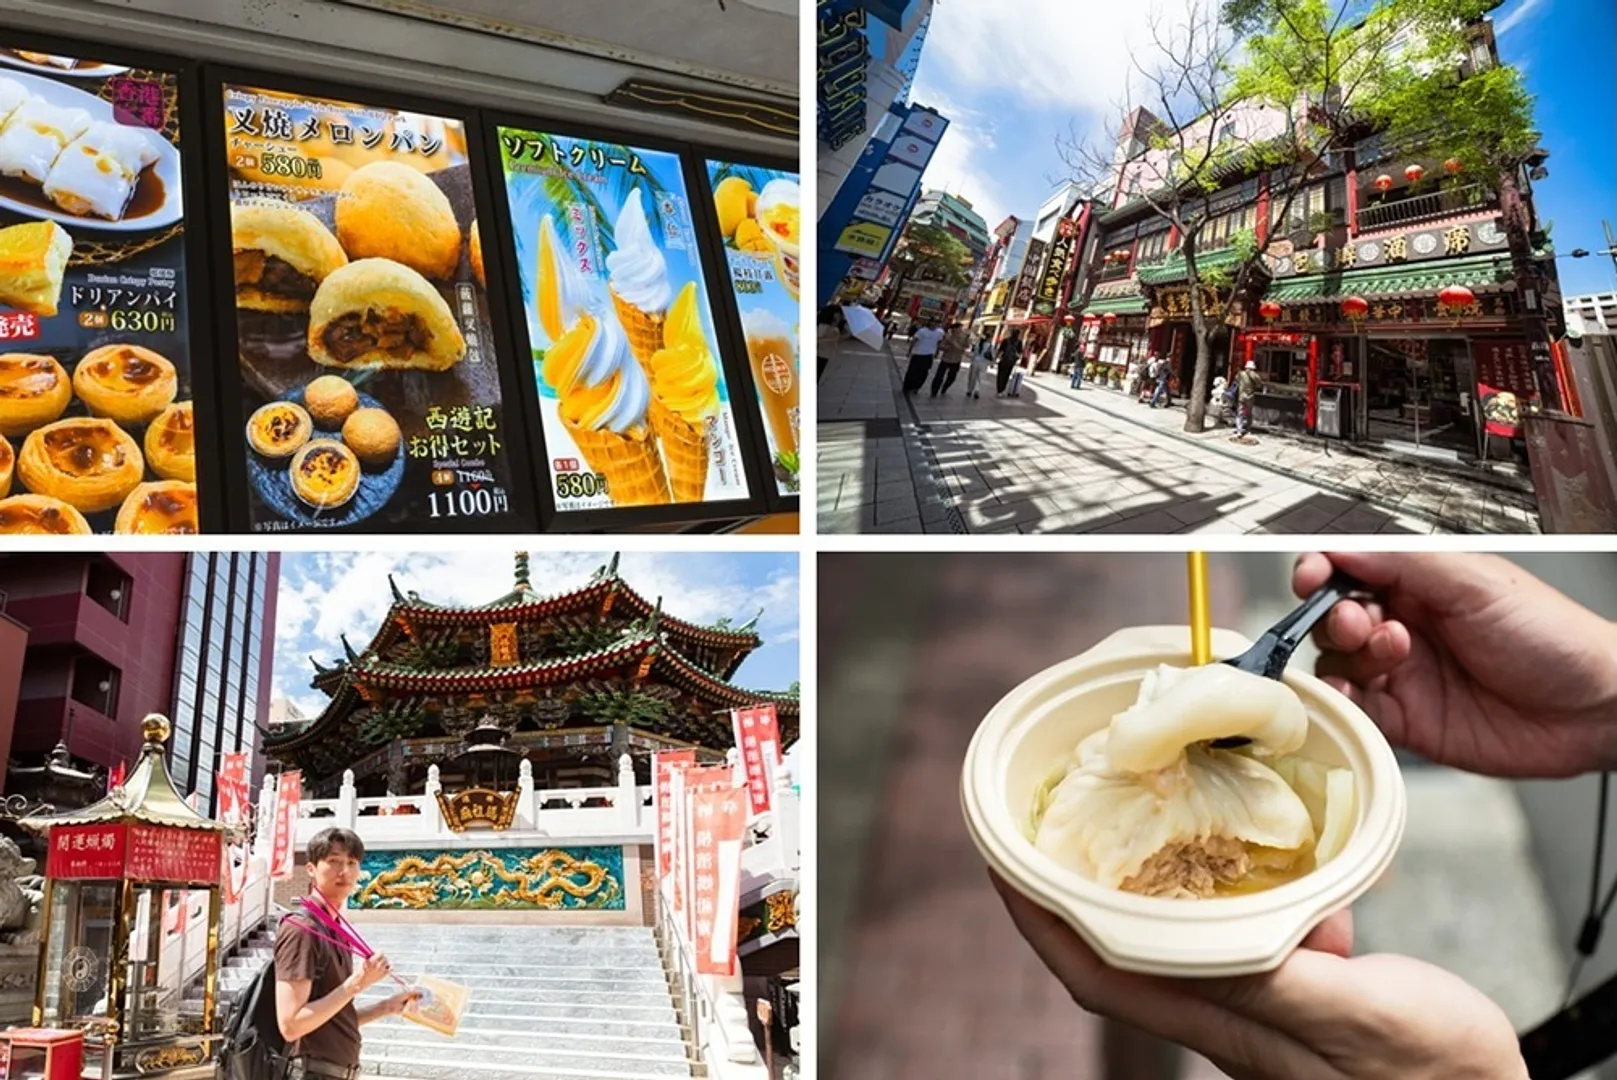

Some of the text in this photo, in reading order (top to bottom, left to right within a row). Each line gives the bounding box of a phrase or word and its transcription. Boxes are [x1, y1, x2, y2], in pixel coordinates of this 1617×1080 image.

[504, 136, 646, 176] ソフトクリーム
[571, 206, 593, 274] ミックス
[71, 286, 177, 309] ドリアンパイ
[426, 405, 497, 432] 西遊記
[409, 433, 502, 459] お得セット
